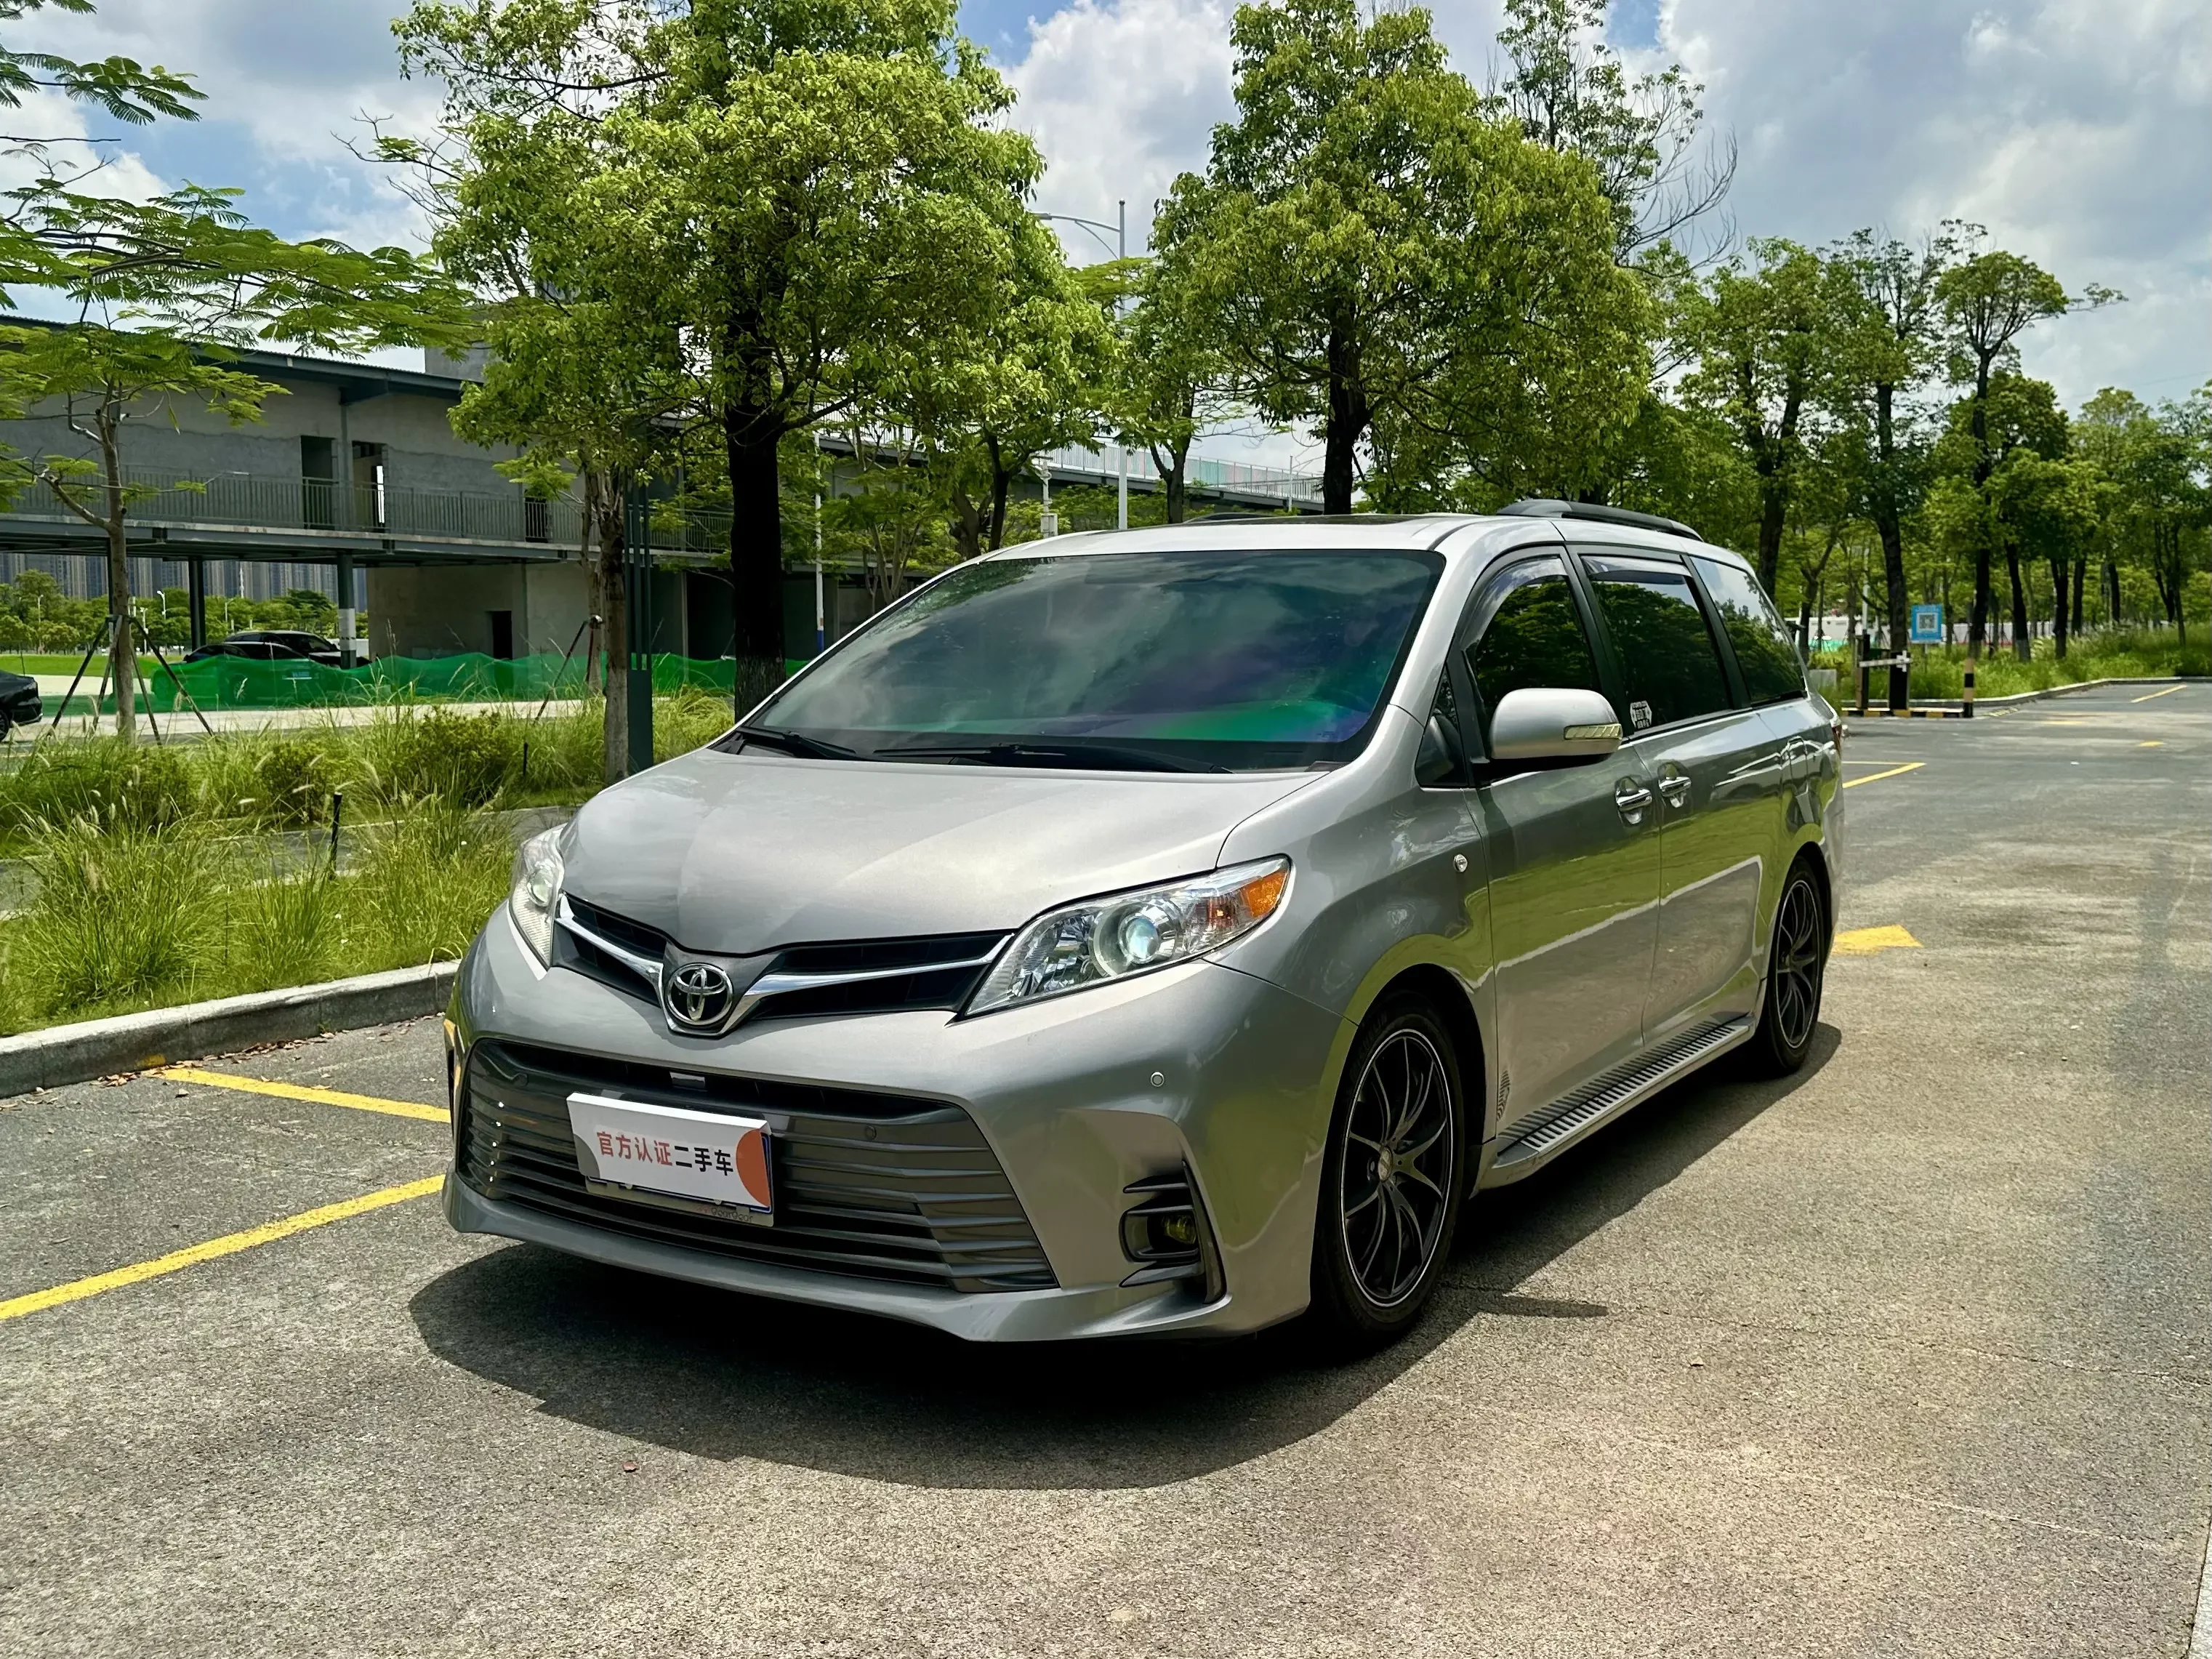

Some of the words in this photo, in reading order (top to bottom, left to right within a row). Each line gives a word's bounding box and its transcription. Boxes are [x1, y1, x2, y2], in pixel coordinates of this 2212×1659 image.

[596, 1130, 734, 1176] 官方认证二手车
